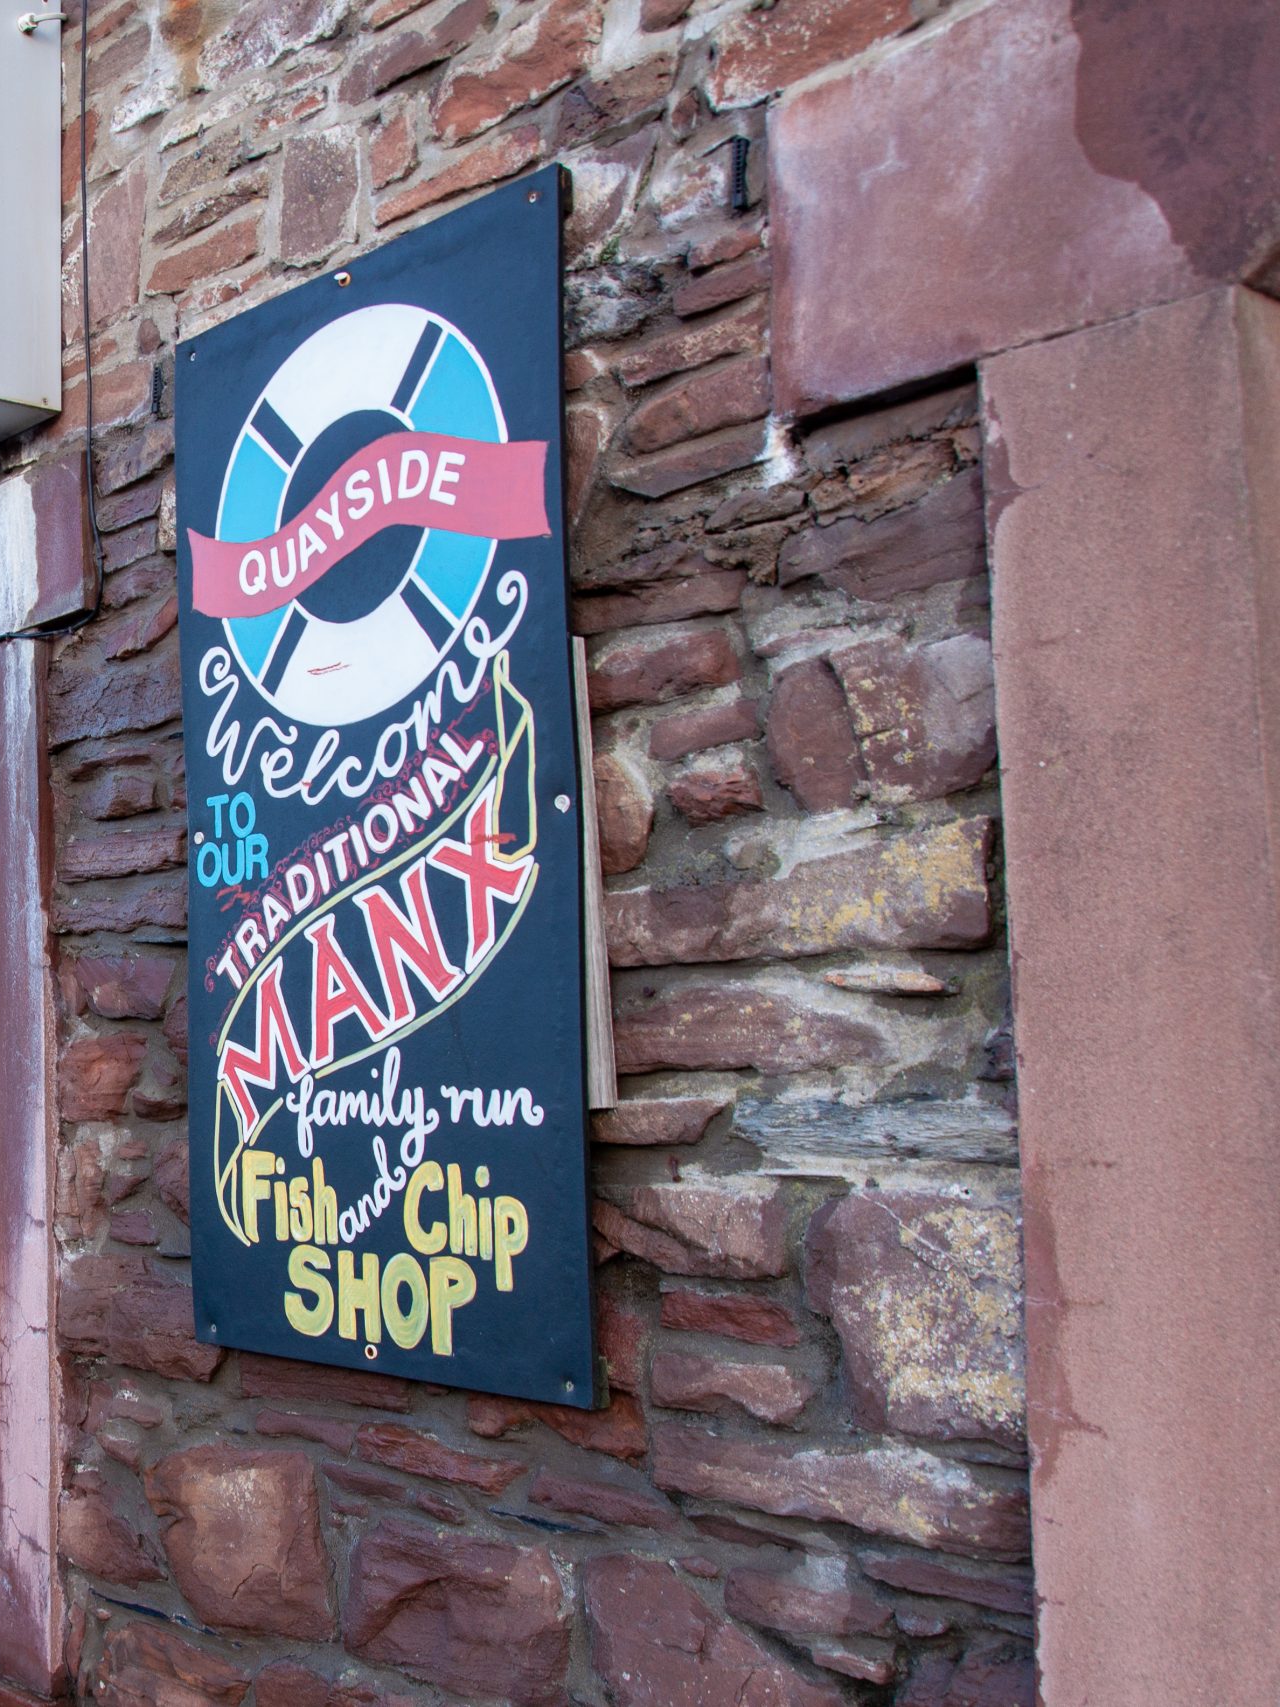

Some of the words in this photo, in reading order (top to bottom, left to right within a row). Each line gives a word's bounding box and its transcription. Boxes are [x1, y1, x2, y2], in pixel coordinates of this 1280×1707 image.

[238, 449, 466, 596] QUAYSIDE
[199, 570, 528, 806] Welcome
[197, 832, 269, 888] OUR
[206, 791, 256, 838] TO
[216, 732, 485, 990] TRADITIONAL
[217, 776, 535, 1143] MANX
[286, 1046, 439, 1168] family
[440, 1087, 544, 1127] run
[242, 1150, 338, 1244] Fish
[338, 1136, 406, 1244] and
[403, 1161, 529, 1292] Chip
[284, 1244, 477, 1356] SHOP
